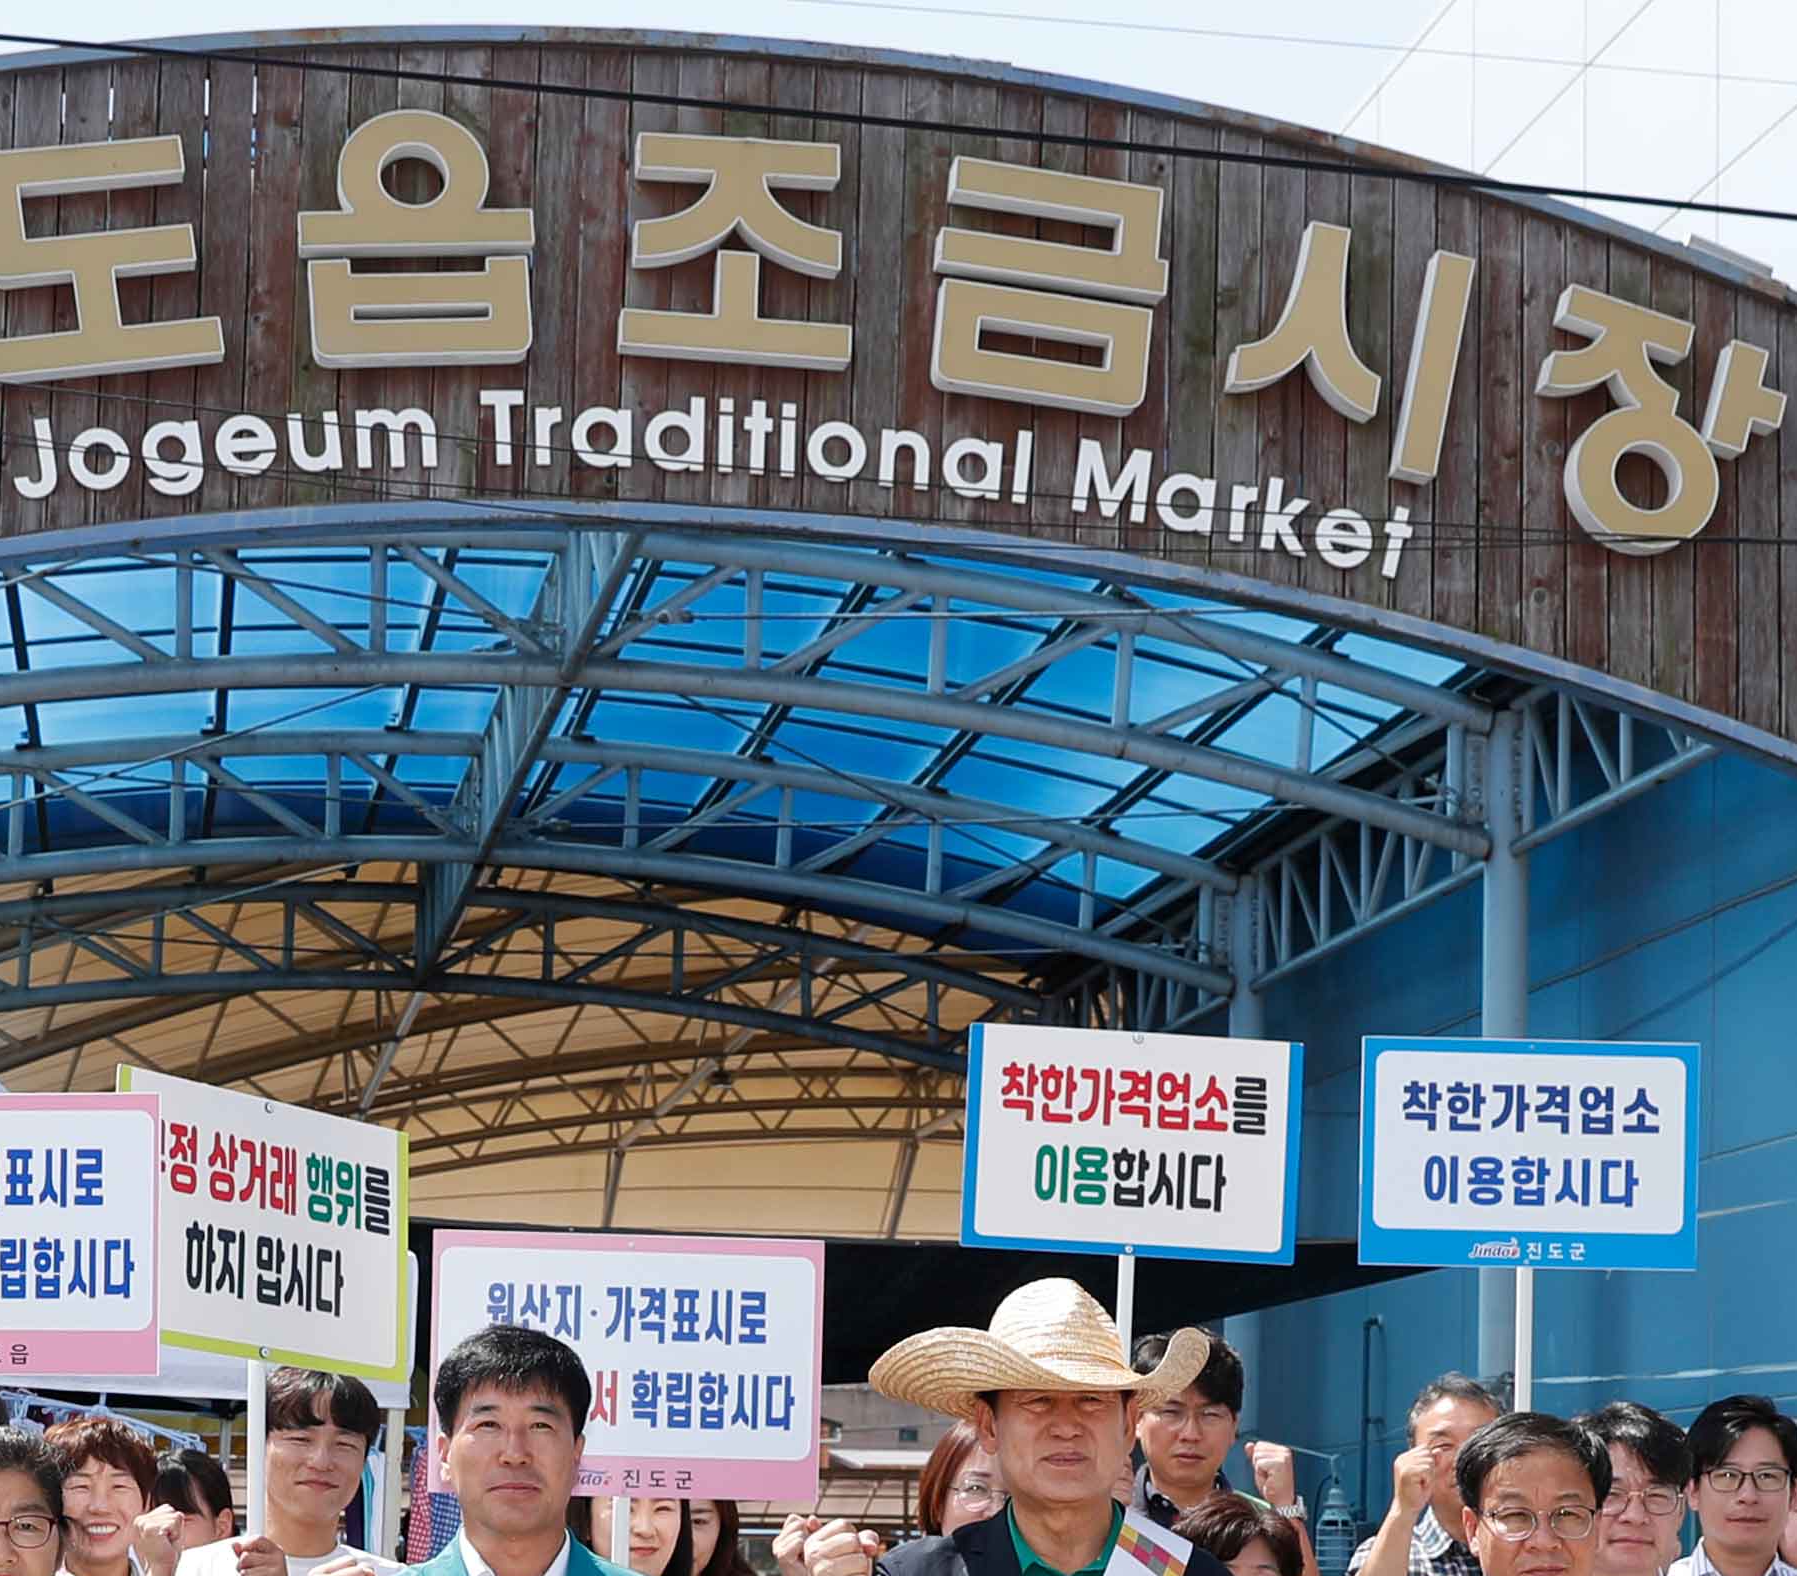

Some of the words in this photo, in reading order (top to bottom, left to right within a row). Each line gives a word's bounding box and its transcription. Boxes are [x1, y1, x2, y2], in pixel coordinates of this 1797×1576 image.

[13, 404, 440, 501] Jogeum
[480, 388, 1035, 505] Traditional
[1071, 438, 1415, 581] Market
[1001, 1061, 1269, 1137] 착한가격업소를
[1401, 1080, 1661, 1137] 착한가격업소
[160, 1120, 198, 1195] 정
[207, 1130, 298, 1217] 상거래
[305, 1152, 391, 1237] 행위를
[1034, 1144, 1227, 1213] 이용합시다
[1423, 1154, 1640, 1209] 이용합시다
[185, 1219, 245, 1301] 하지
[256, 1233, 345, 1318] 맙시다
[1526, 1241, 1587, 1262] 진도군
[630, 1369, 796, 1432] 확립합시다
[621, 1468, 695, 1491] 진도군
